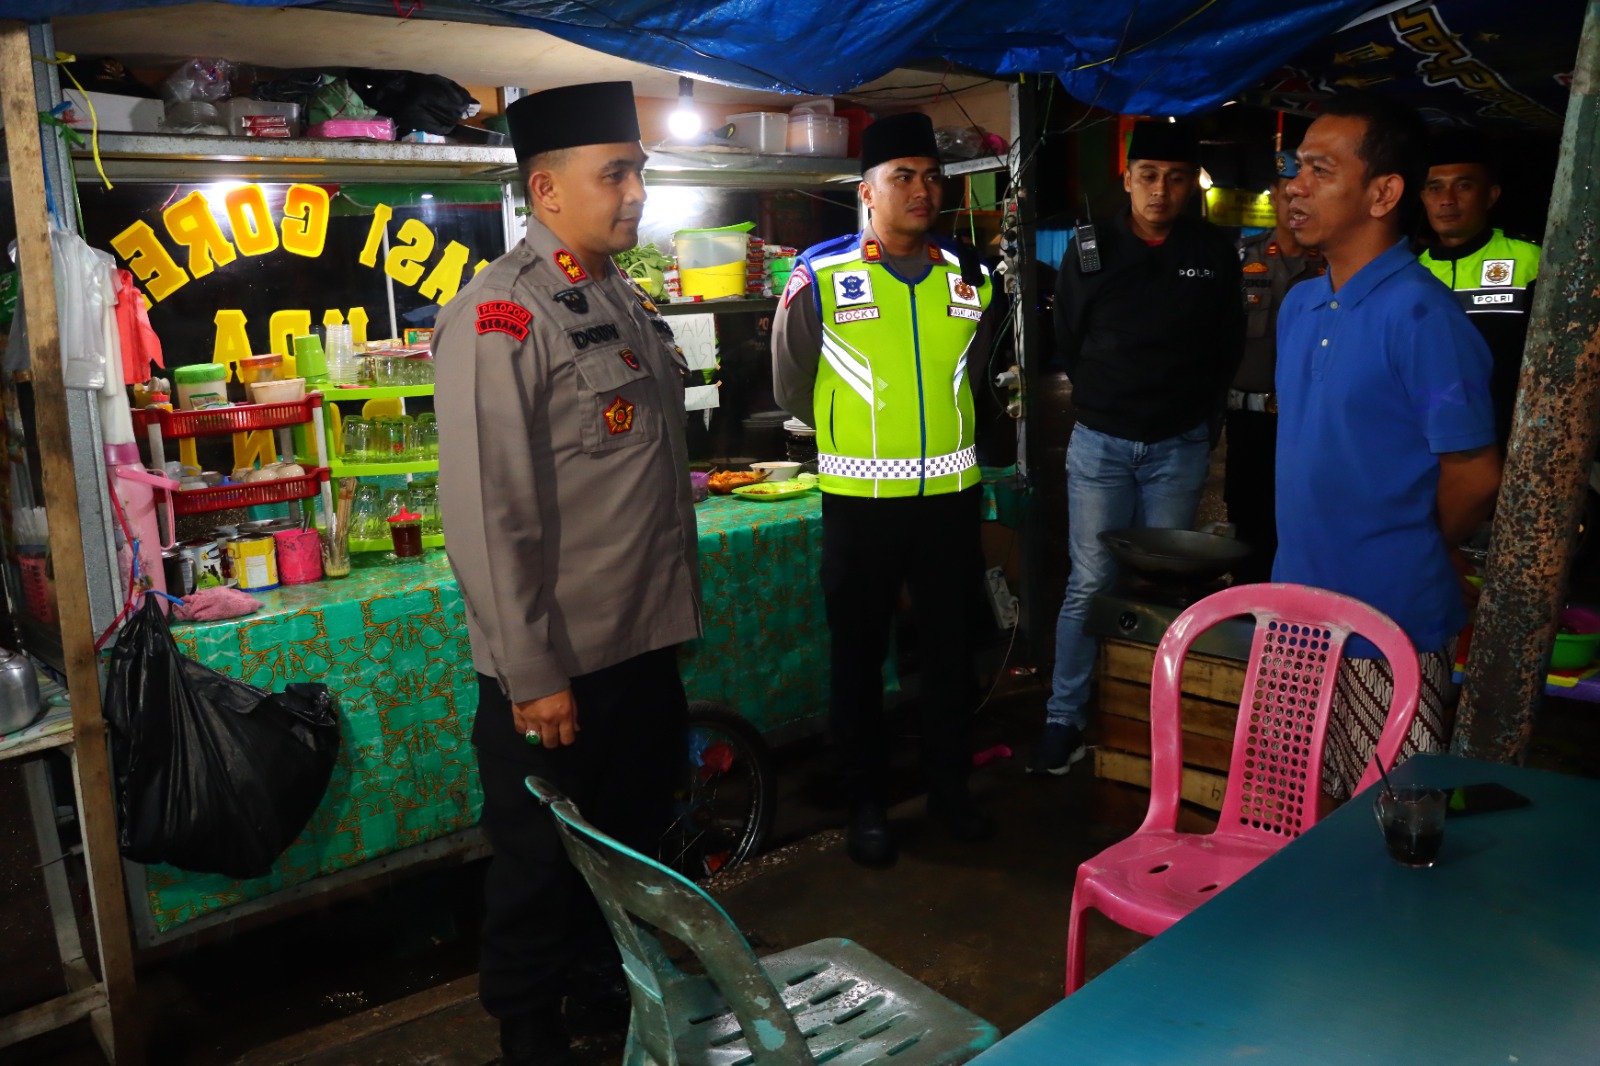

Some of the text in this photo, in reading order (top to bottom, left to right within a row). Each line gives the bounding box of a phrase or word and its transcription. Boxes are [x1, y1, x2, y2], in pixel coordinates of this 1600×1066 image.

[1178, 268, 1214, 278] POLRI
[1477, 295, 1510, 303] POLRI
[481, 303, 527, 320] PELOPOR
[837, 309, 876, 321] ROCKY
